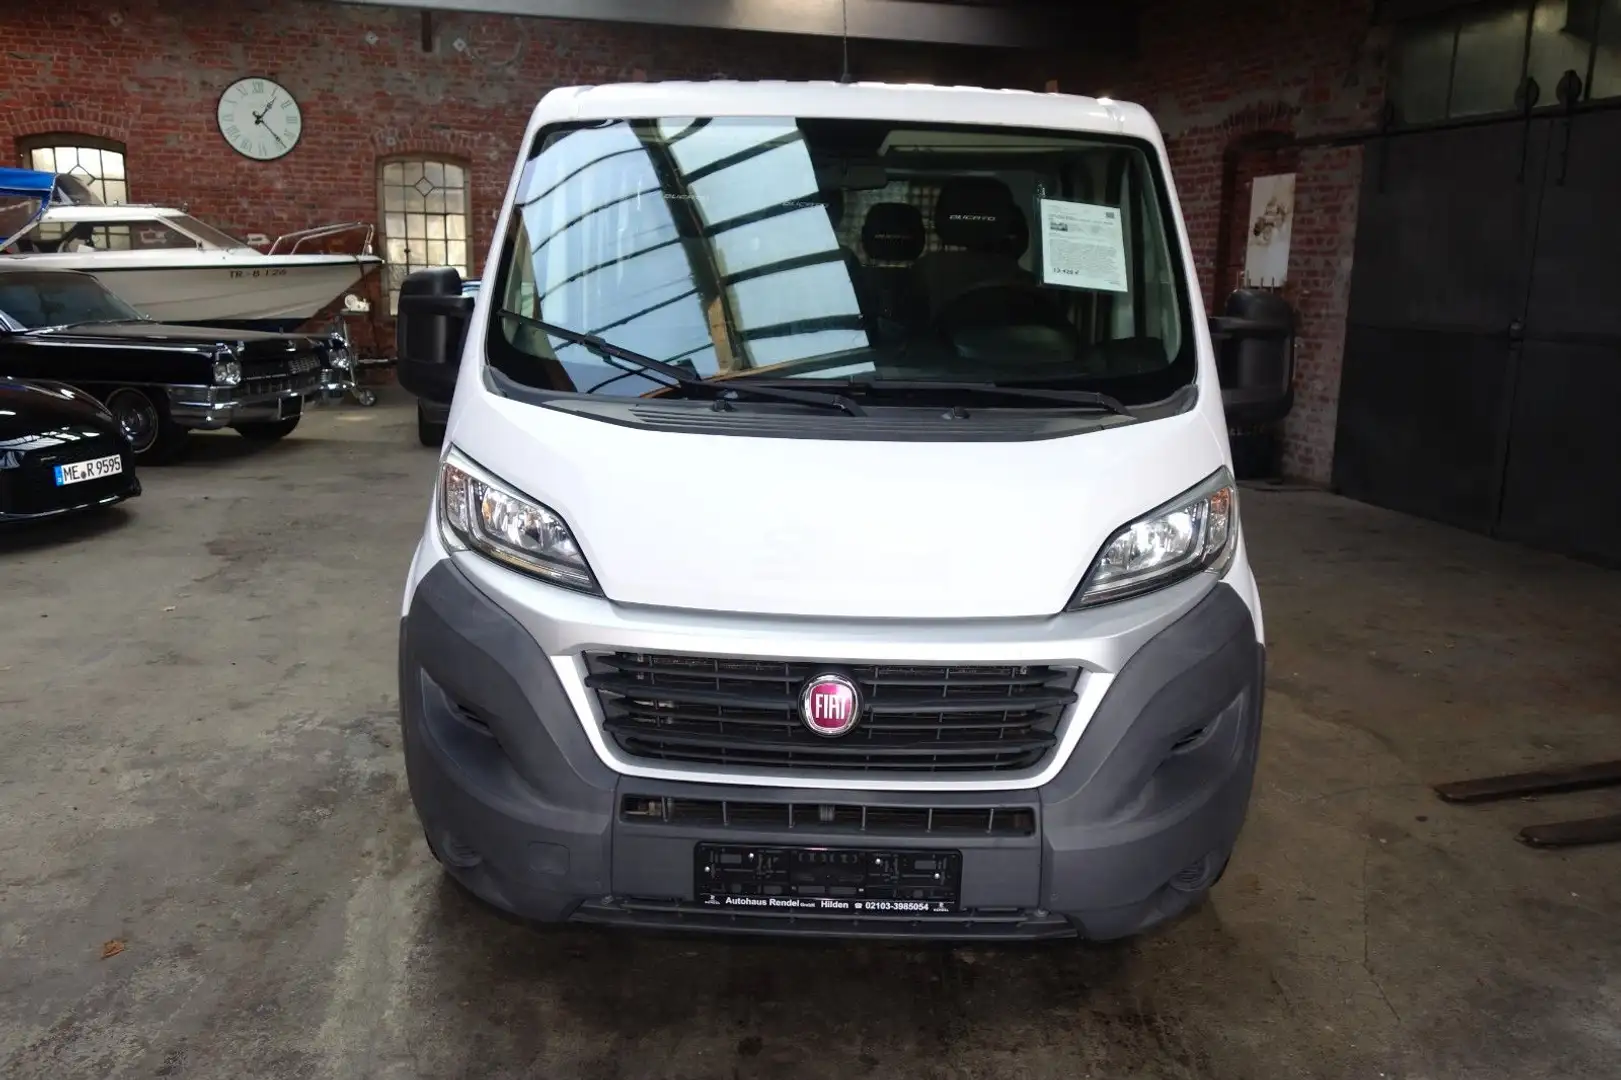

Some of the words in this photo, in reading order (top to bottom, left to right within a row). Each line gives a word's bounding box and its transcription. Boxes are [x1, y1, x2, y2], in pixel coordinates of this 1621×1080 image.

[63, 465, 81, 482] ME
[86, 462, 95, 477] R
[96, 457, 121, 475] 9595
[815, 693, 848, 720] FIAT
[725, 896, 767, 906] Autohaus
[769, 898, 800, 907] Rendel
[820, 900, 849, 909] Hilden
[865, 901, 929, 911] 02103-3985054
